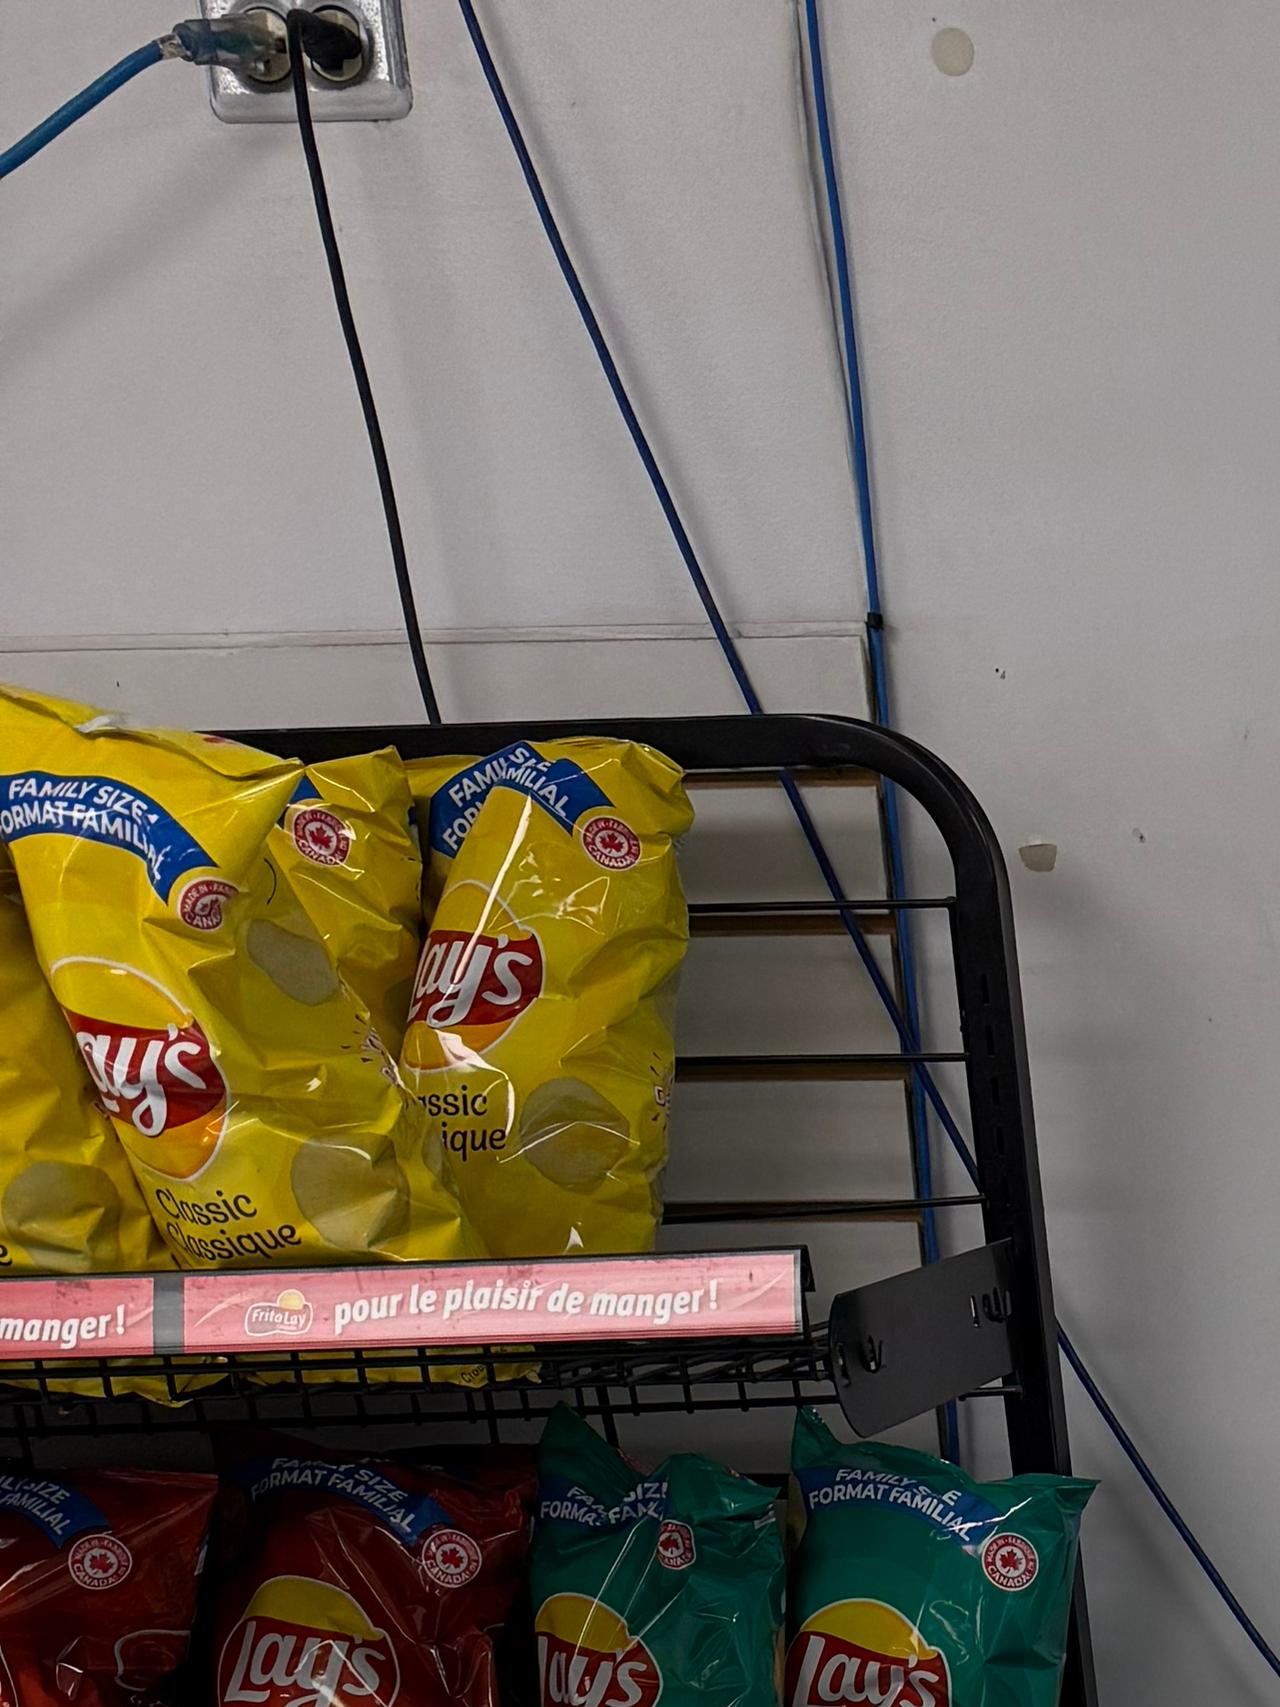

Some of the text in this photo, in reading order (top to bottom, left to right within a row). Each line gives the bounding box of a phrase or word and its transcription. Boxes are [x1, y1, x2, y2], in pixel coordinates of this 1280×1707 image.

[9, 777, 148, 823] FAMILY SIZE
[156, 1188, 258, 1225] Classic
[166, 1221, 302, 1261] Classique
[335, 1280, 584, 1335] pour le plaisir de
[835, 1468, 918, 1487] FAMILY
[250, 1469, 417, 1533] FORMAT FAMILIAL
[808, 1484, 977, 1541] FORMAT FAMILIAL
